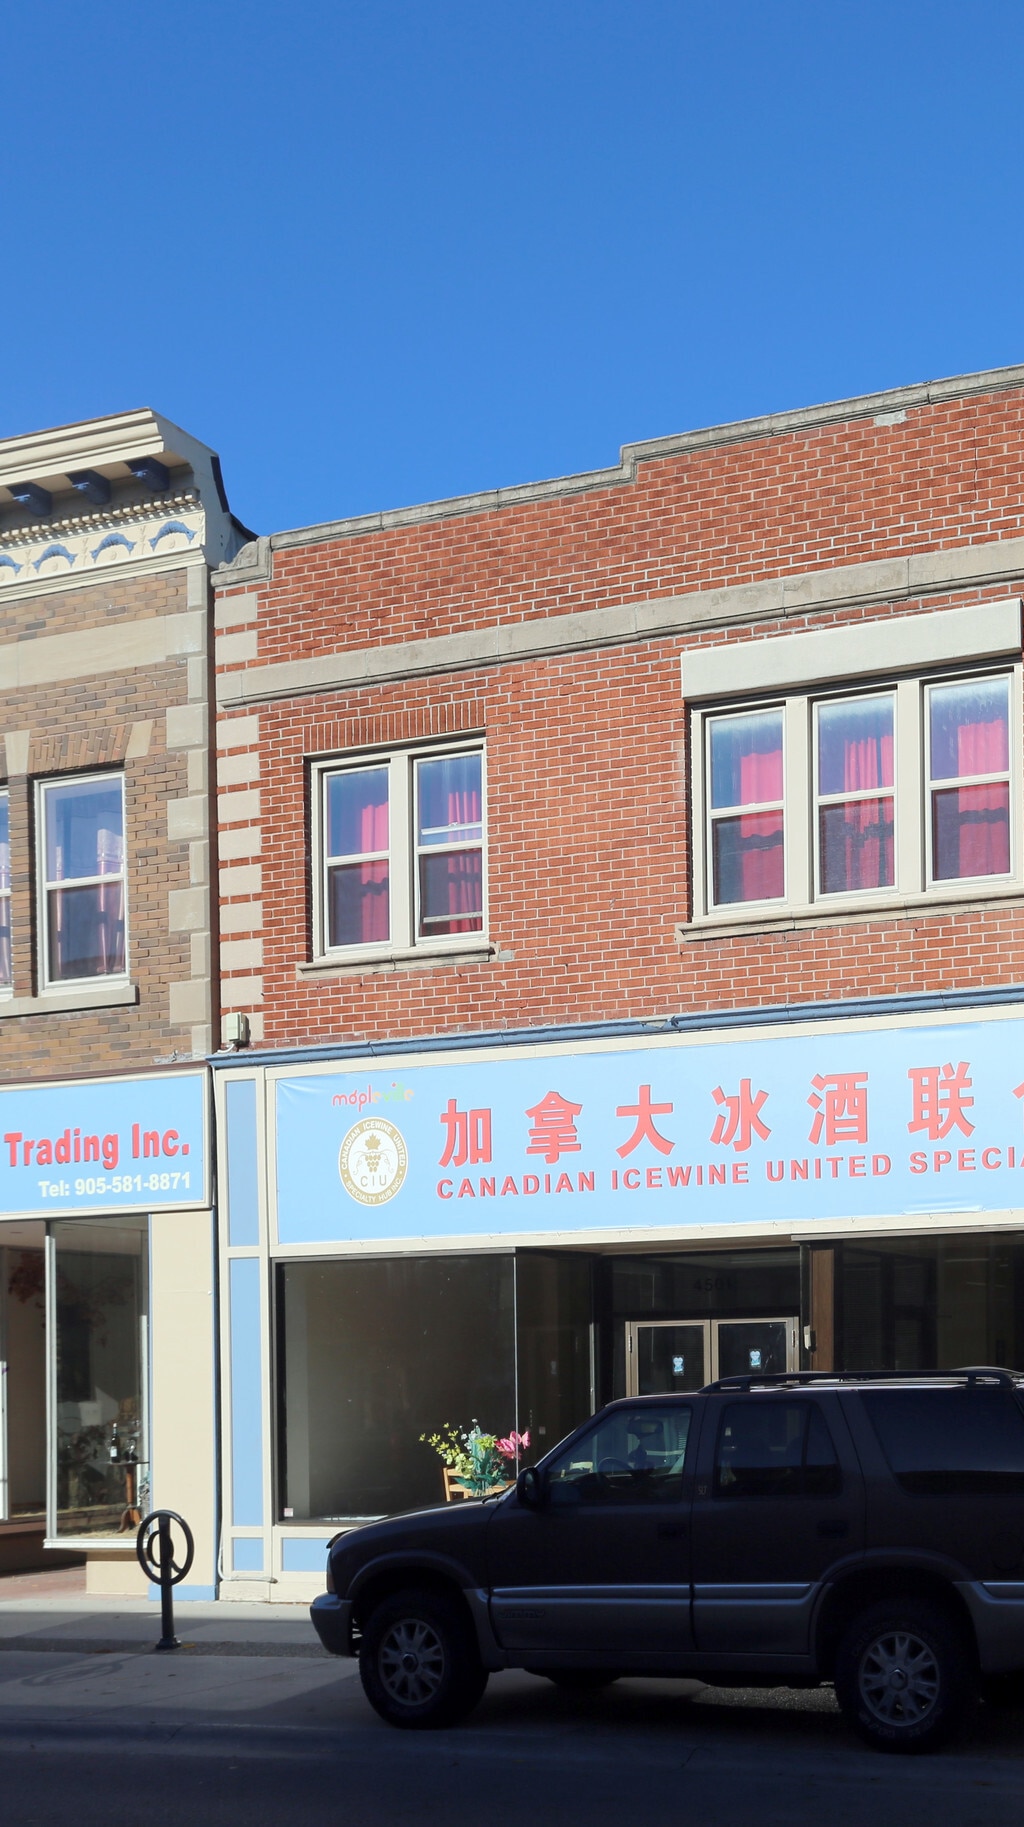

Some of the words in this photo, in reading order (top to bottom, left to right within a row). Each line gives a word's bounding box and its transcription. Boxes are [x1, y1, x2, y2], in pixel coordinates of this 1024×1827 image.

[3, 1127, 120, 1170] Trading
[131, 1122, 191, 1159] Inc.
[341, 1127, 361, 1170] CANADIAN
[363, 1120, 393, 1135] ICEWINE
[394, 1134, 406, 1167] UNITED
[38, 1179, 70, 1198] Tel:
[75, 1171, 191, 1196] 905-581-8871
[345, 1181, 377, 1203] SPECIALTY
[379, 1190, 394, 1202] HUB
[436, 1171, 595, 1200] CANADIAN
[611, 1162, 749, 1190] ICEWINE
[766, 1154, 892, 1183] UNITED
